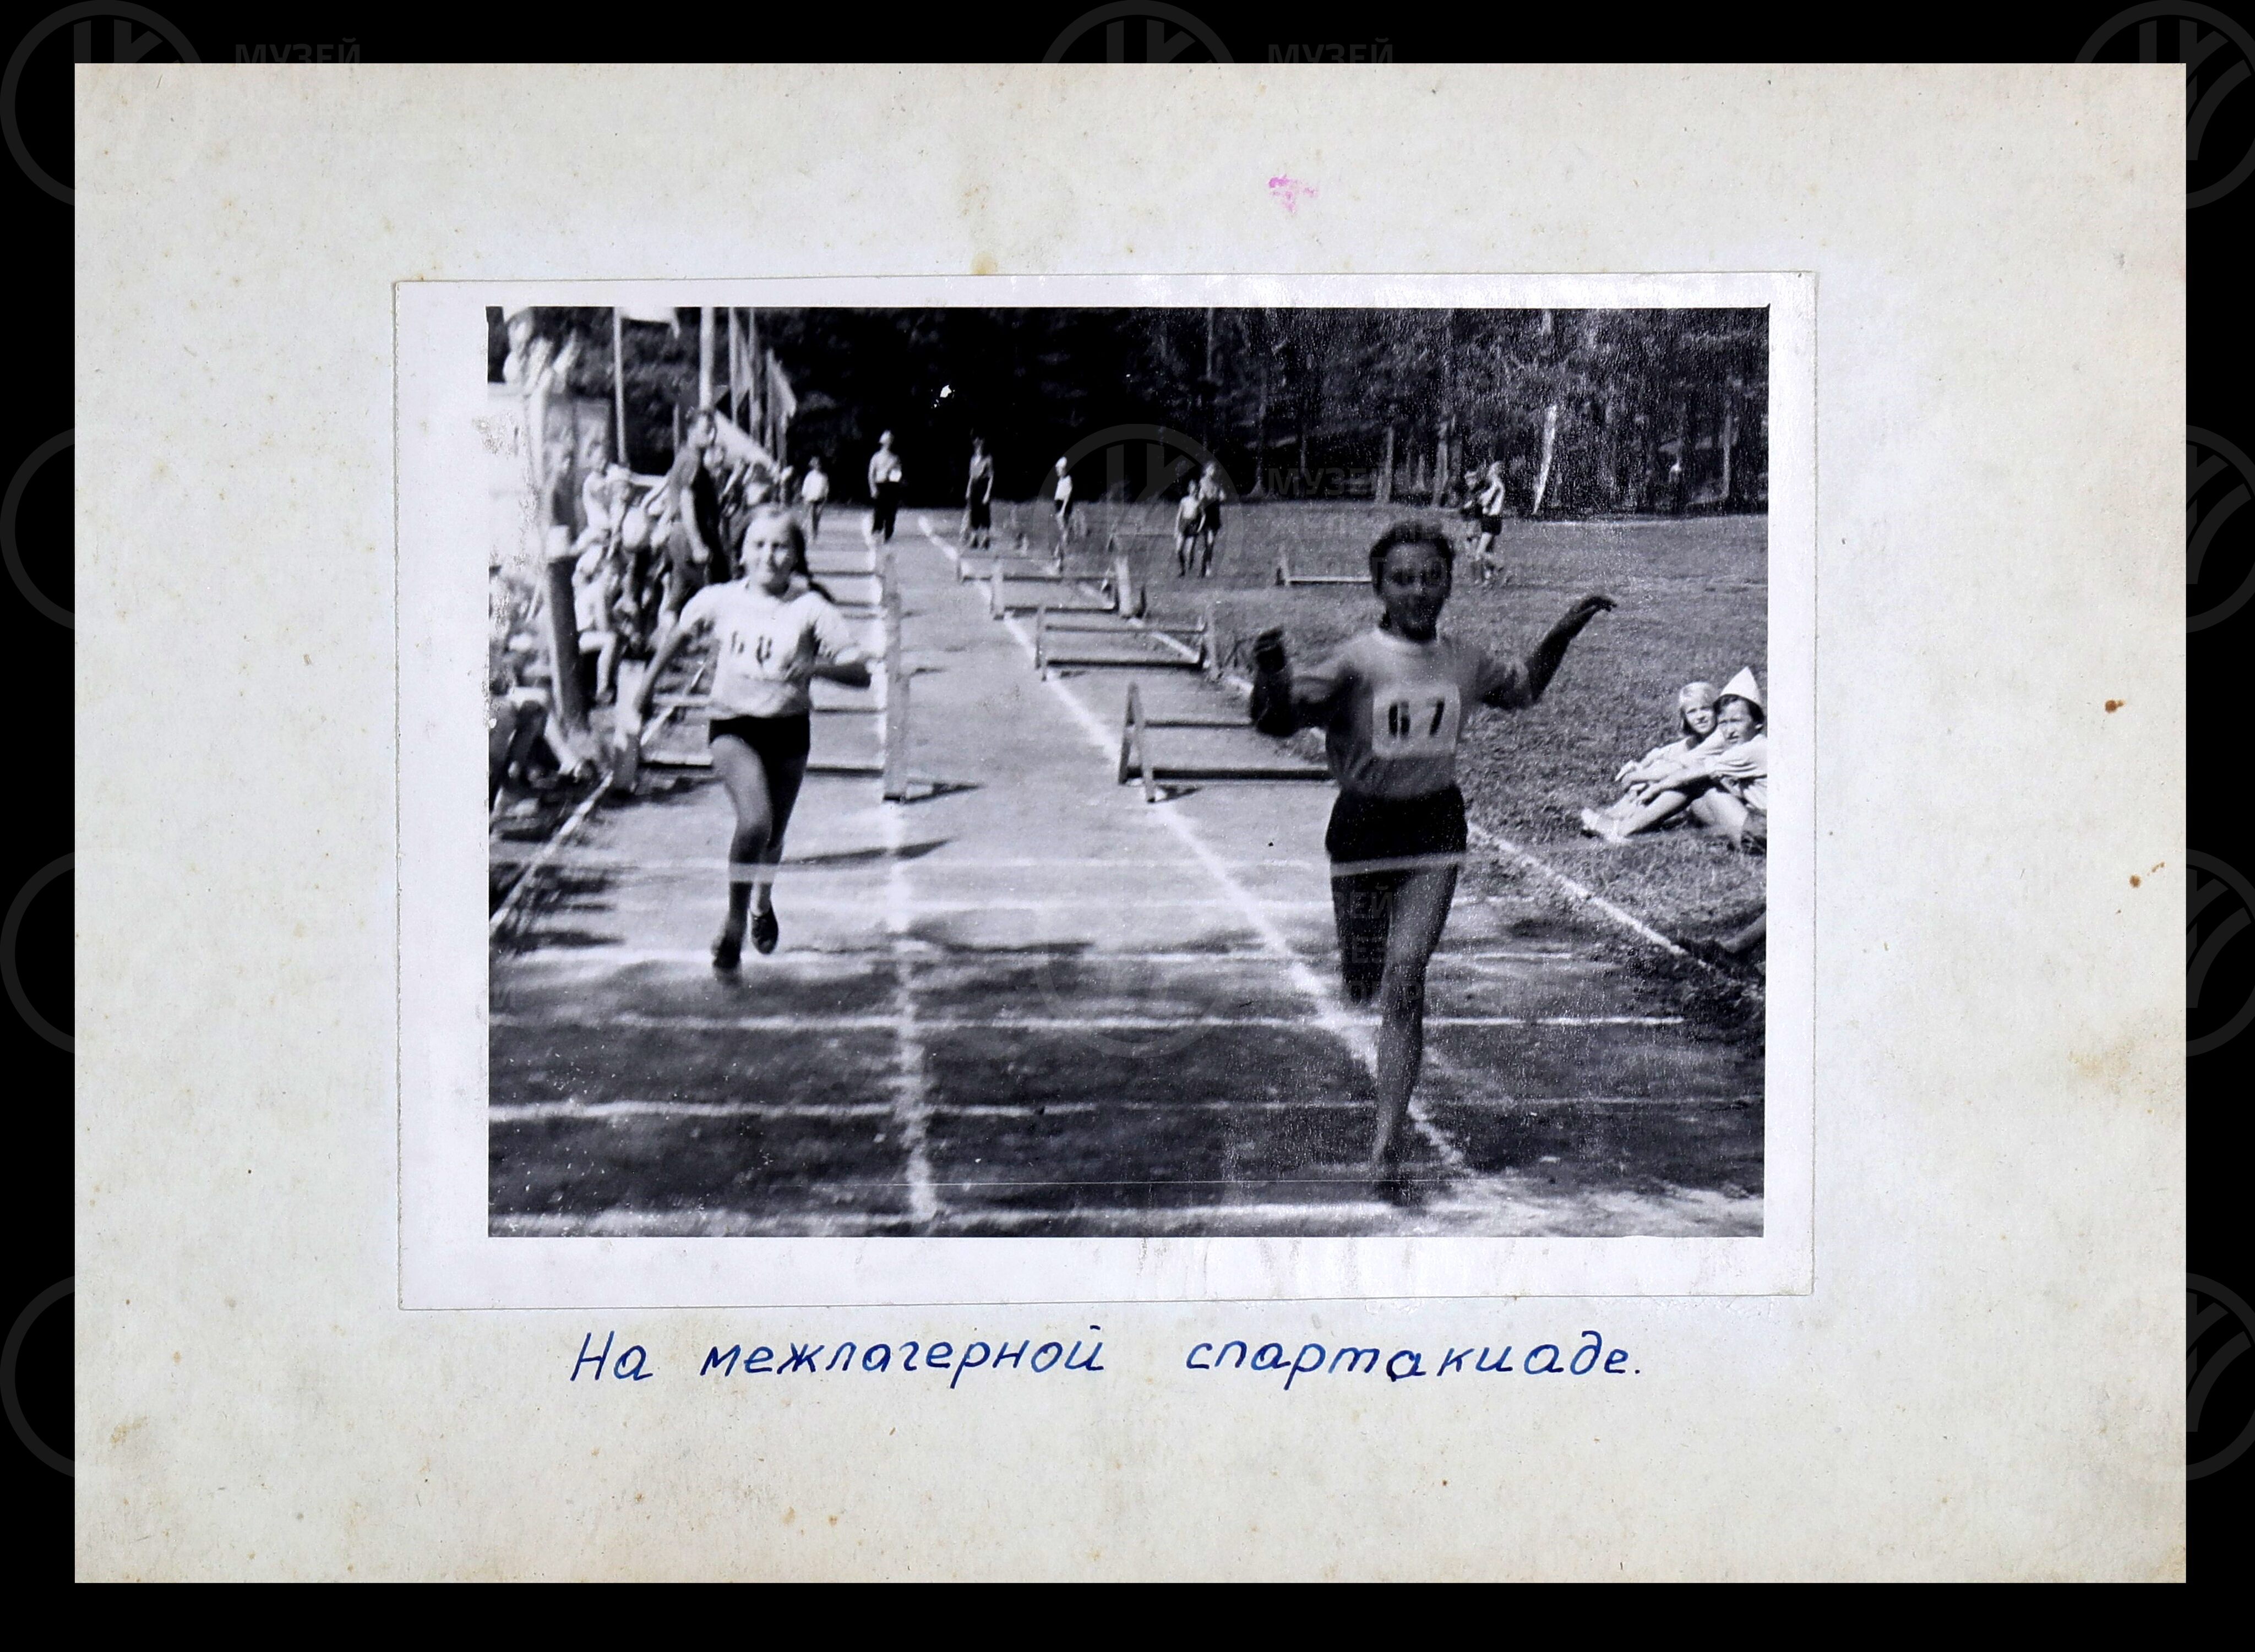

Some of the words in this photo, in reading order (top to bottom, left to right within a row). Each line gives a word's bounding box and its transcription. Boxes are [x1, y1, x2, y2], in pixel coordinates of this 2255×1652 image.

[570, 1330, 654, 1382] На
[699, 1324, 1105, 1390] межлагерной
[1185, 1329, 1642, 1391] спартакиаде.
